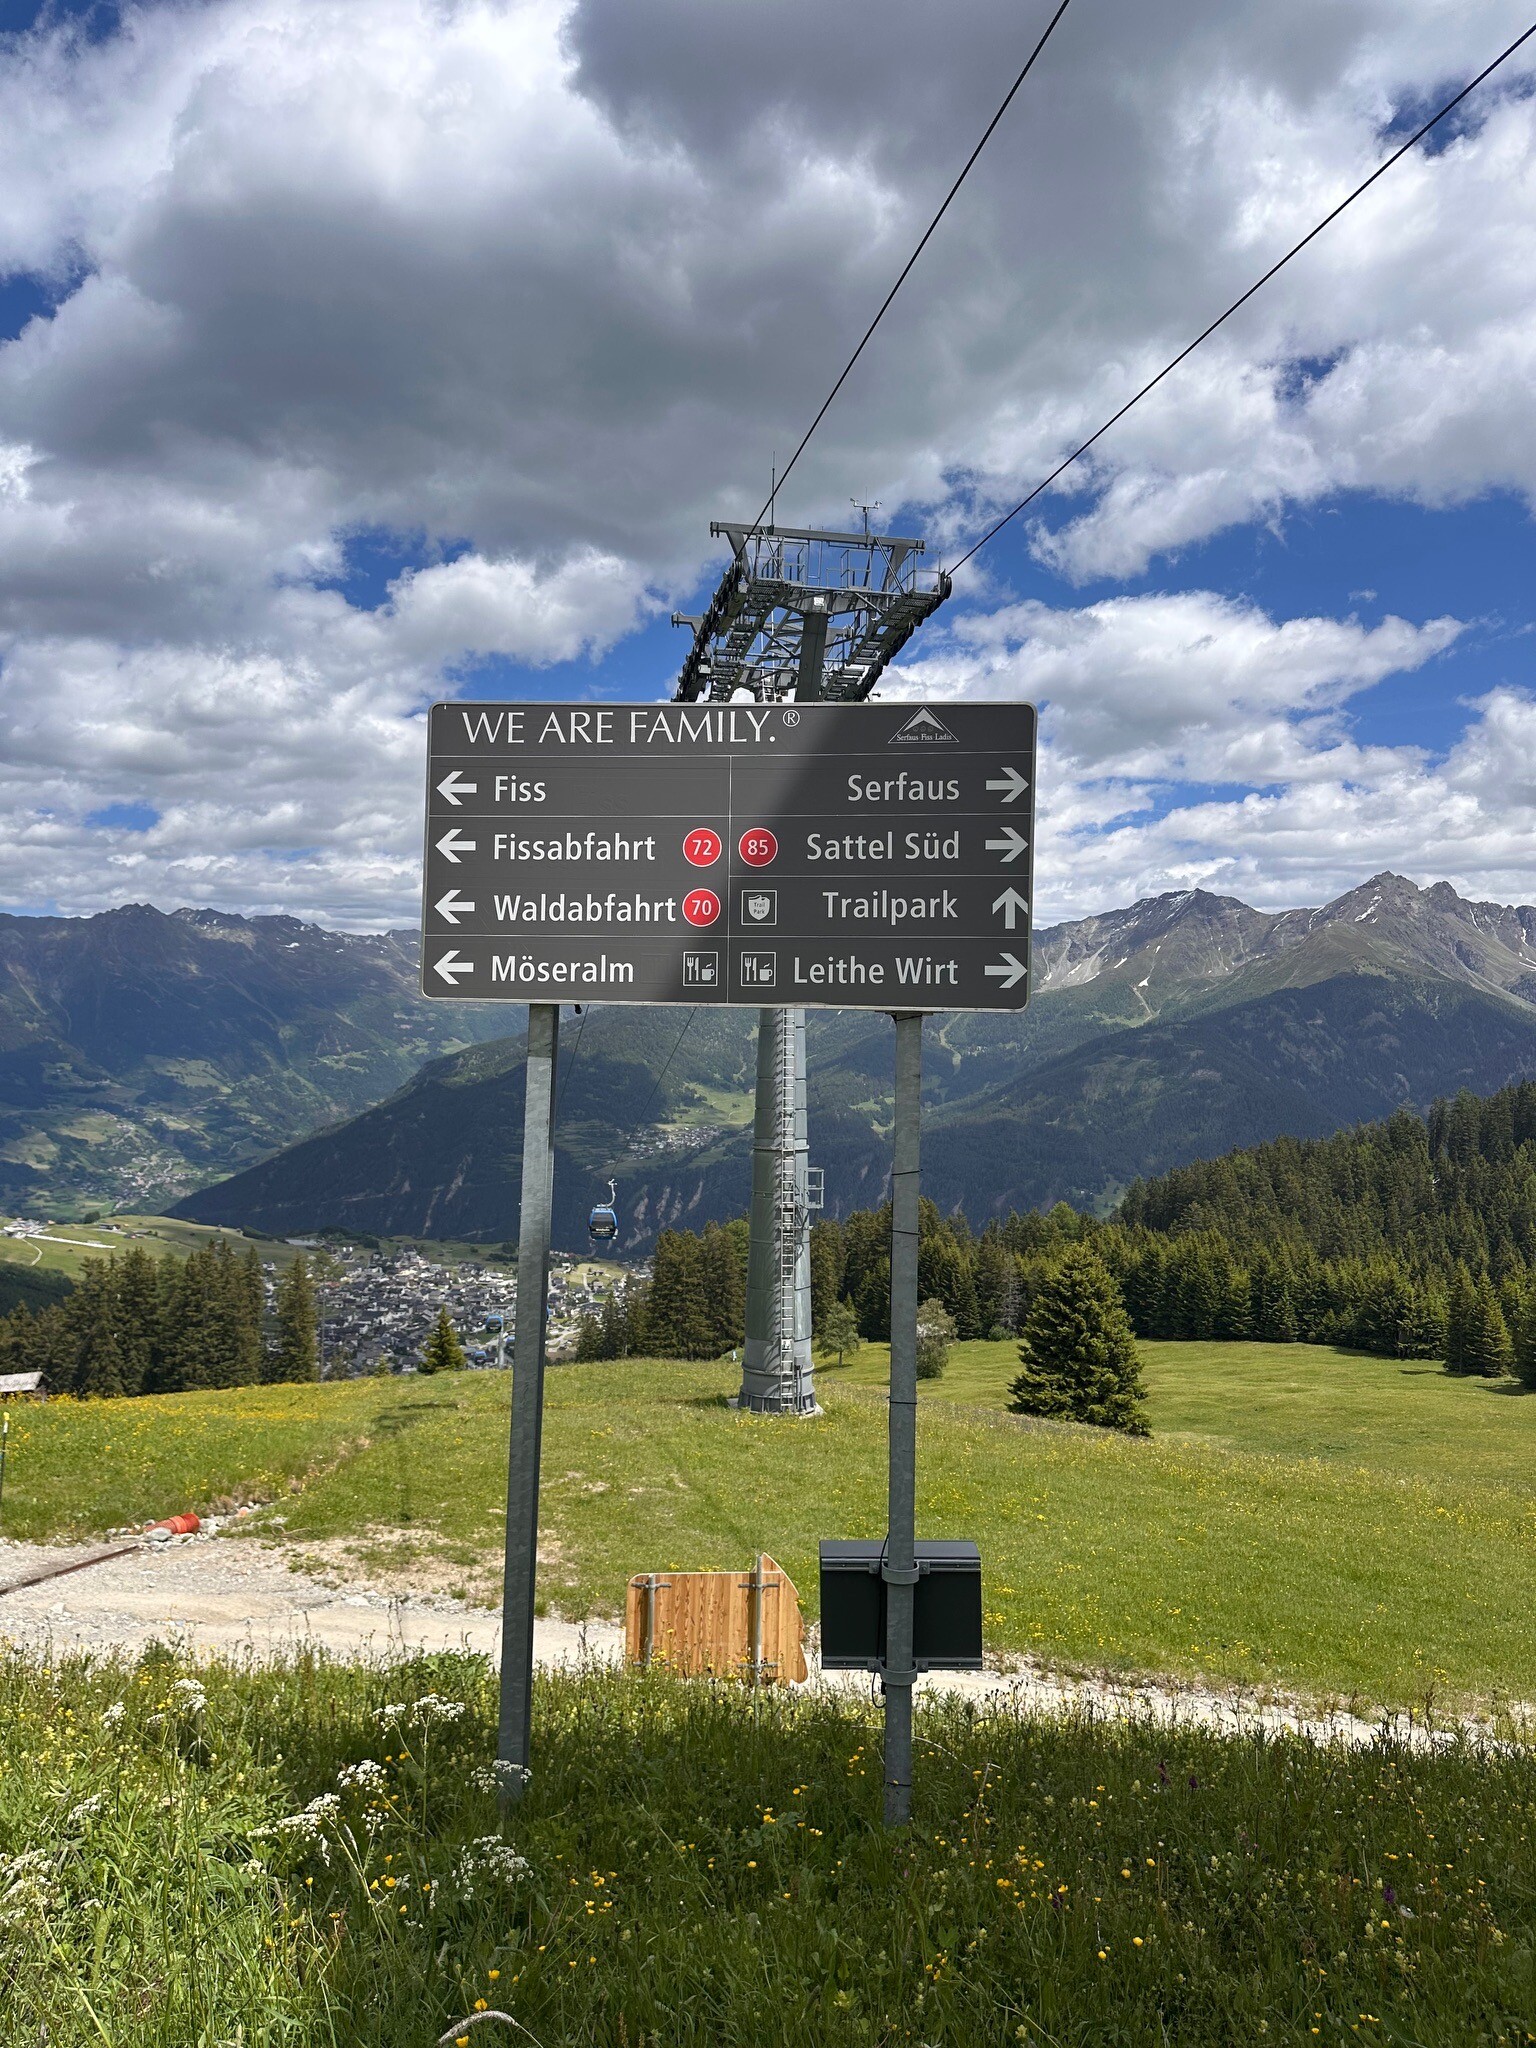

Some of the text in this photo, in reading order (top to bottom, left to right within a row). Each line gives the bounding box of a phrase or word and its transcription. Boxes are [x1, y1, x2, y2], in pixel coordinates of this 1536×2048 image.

[461, 711, 525, 744] WE
[538, 711, 614, 744] ARE
[896, 733, 919, 741] Serfaus
[920, 733, 933, 741] Fiss
[494, 774, 547, 802] Fiss
[846, 771, 960, 802] Serfaus
[493, 831, 713, 861] Fissabfahrt 72
[746, 830, 960, 861] 85 Sattel Süd
[493, 893, 713, 923] Waldabfahrt 70
[822, 889, 959, 926] Trailpark
[490, 954, 634, 984] Möseralm
[793, 955, 960, 985] Leithe Wirt
